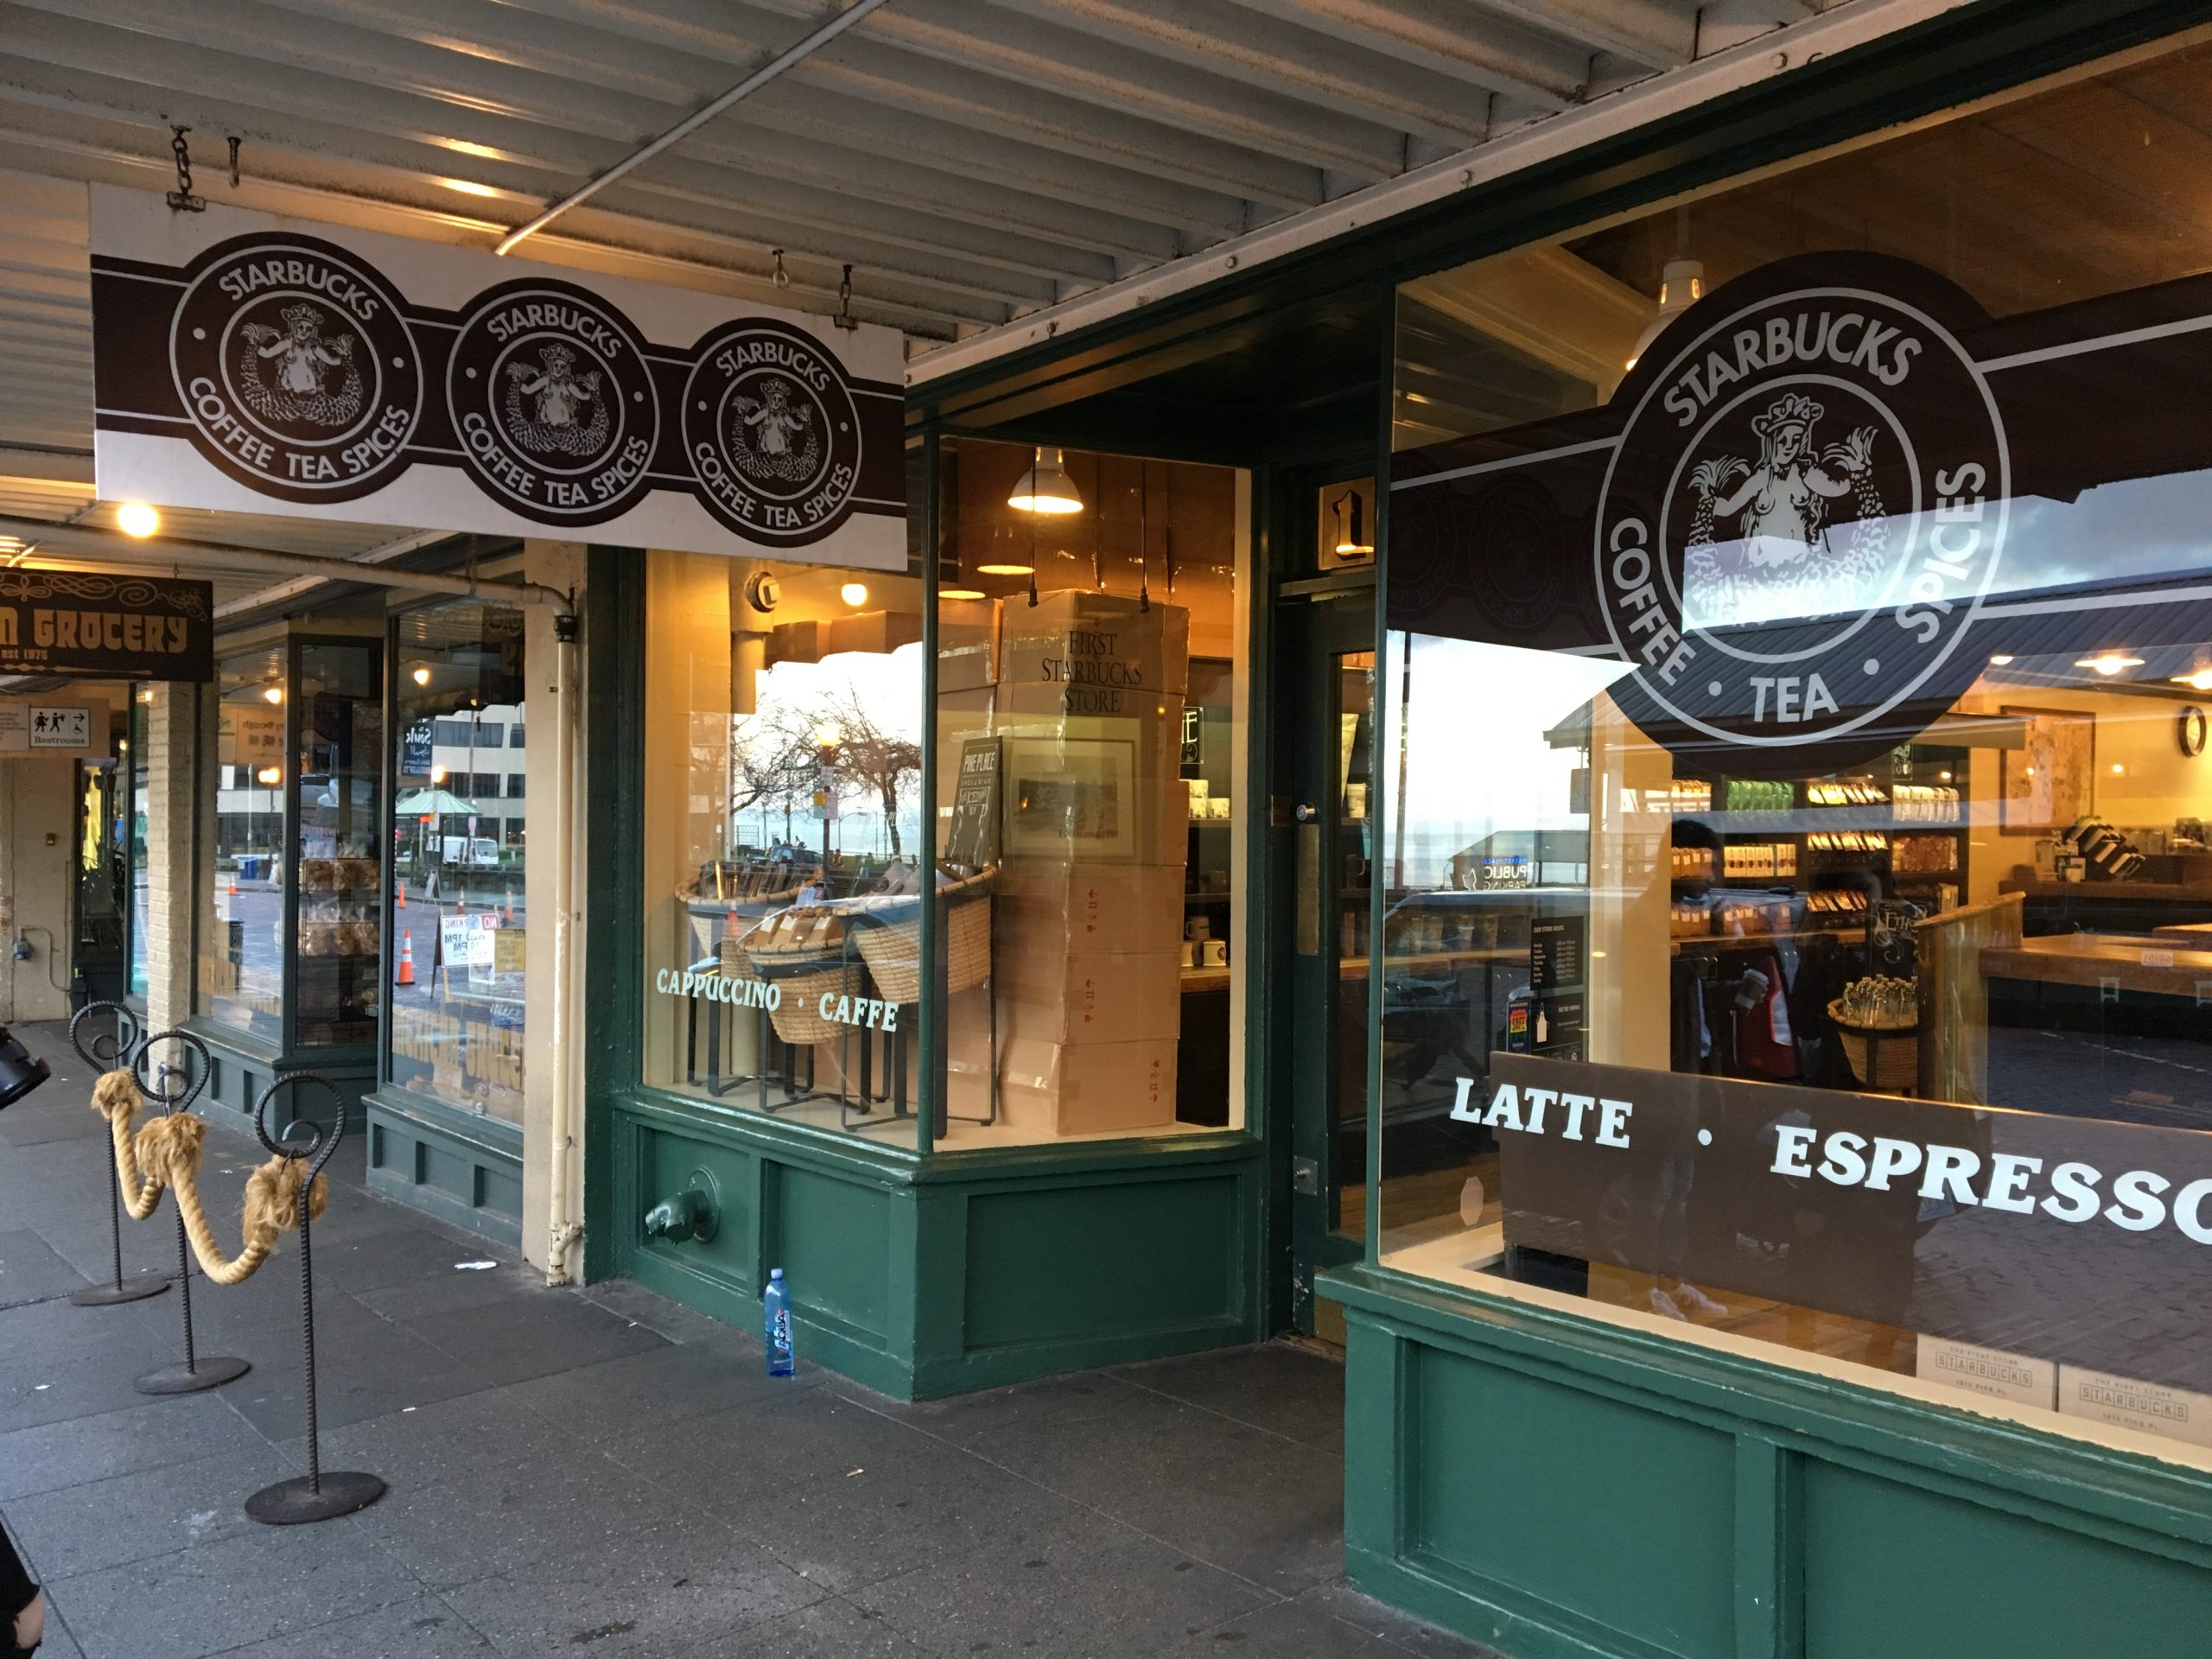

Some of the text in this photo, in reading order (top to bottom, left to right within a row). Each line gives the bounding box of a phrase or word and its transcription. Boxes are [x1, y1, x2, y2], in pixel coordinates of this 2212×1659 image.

[219, 260, 379, 321] STARBUCKS
[486, 304, 622, 359] STARBUCKS
[715, 342, 830, 391] STARBUCKS
[1664, 312, 1923, 428] STARBUCKS
[189, 377, 410, 480] COFFEE TEA SPICES
[463, 411, 649, 505] COFFEE TEA SPICES
[696, 442, 853, 527] COFFEE TEA SPICES
[1895, 461, 1987, 645] SPICES
[1610, 518, 1697, 687] COFFEE
[34, 608, 188, 653] GROCERY
[1068, 630, 1118, 655] FIRST
[1041, 658, 1142, 685] STARBUCKS
[1065, 687, 1121, 713] STORE
[1750, 673, 1840, 723] TEA
[34, 736, 85, 745] Restrooms
[657, 968, 899, 1033] CAPPUCCINO CAFFE
[1512, 1016, 1526, 1031] SAFE
[1449, 1077, 1633, 1149] LATTE
[777, 1313, 786, 1348] AQUA
[1938, 1354, 2030, 1384] STARBUCKS
[1967, 1350, 1989, 1360] FIRST
[1993, 1356, 2018, 1366] STORE
[2082, 1388, 2184, 1418] STARBUCKS
